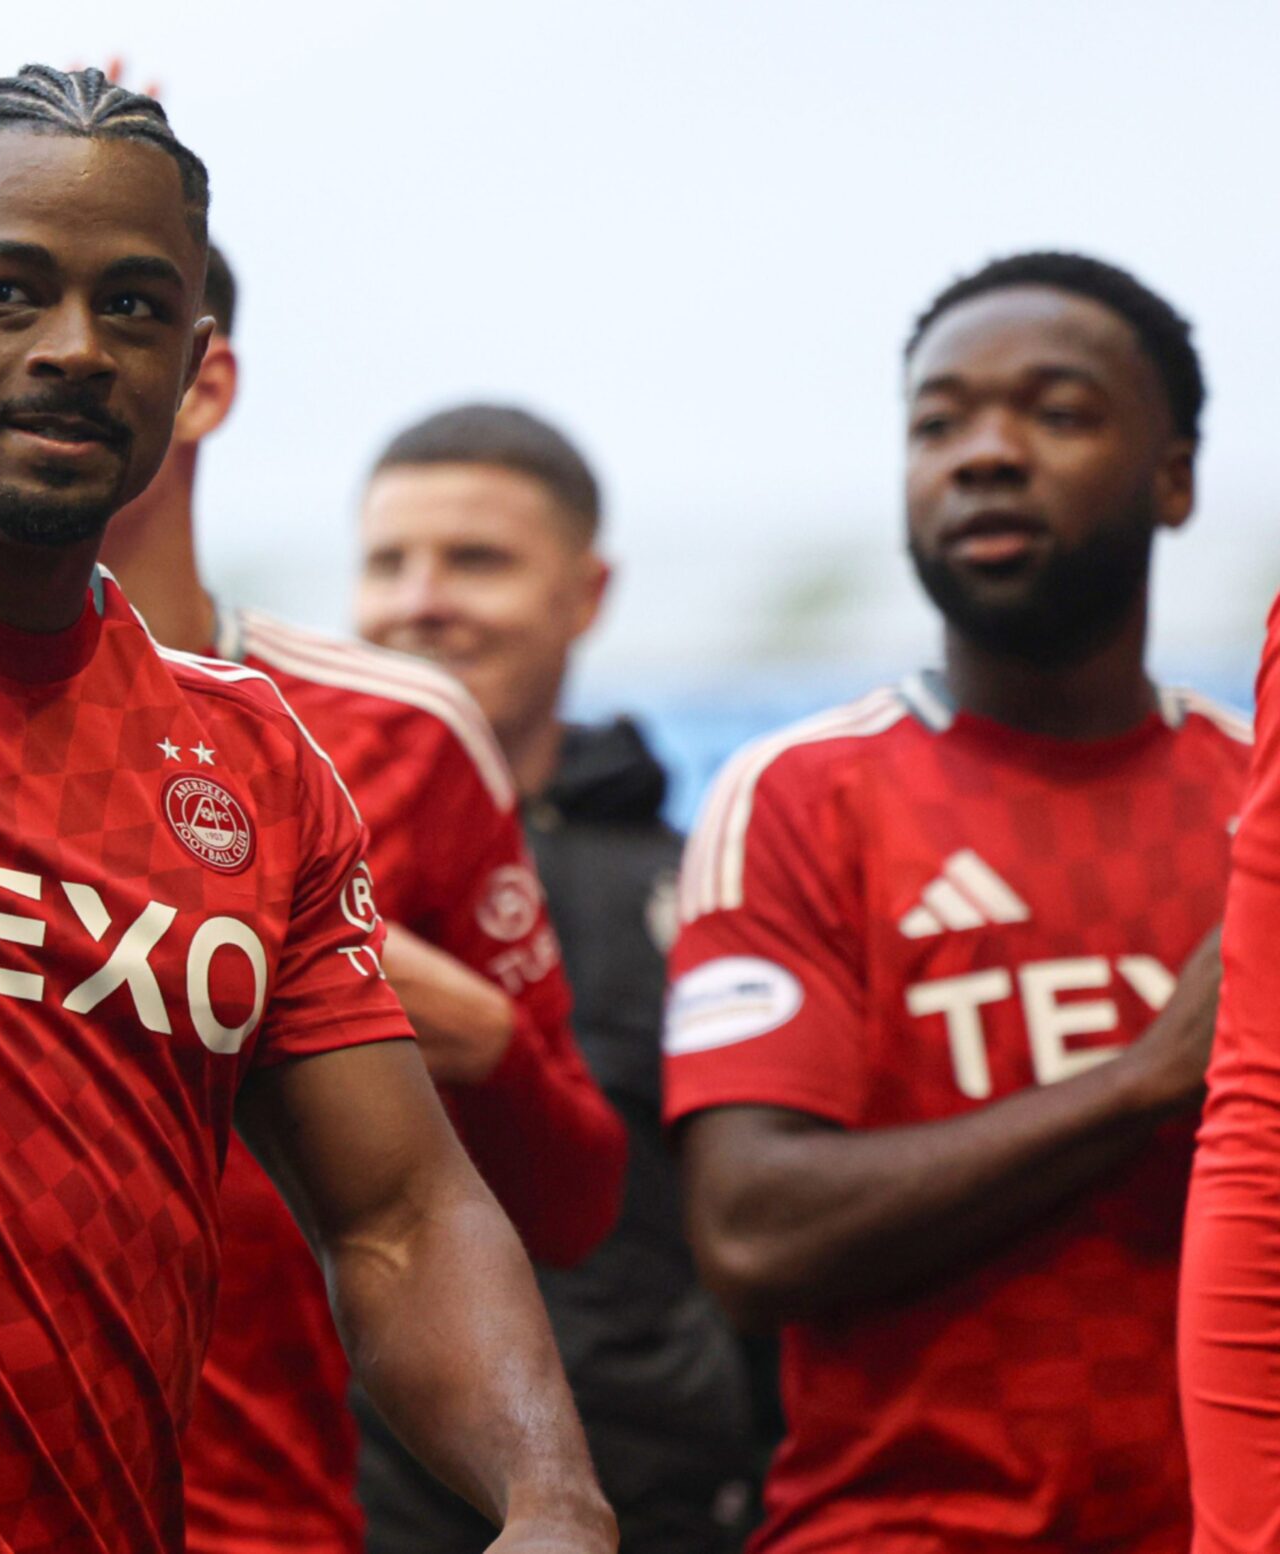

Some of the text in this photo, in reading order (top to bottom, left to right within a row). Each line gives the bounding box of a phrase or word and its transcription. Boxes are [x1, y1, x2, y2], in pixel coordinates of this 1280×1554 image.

[174, 781, 232, 807] ABERDEEN
[175, 821, 248, 864] FOOTBALL CLUB
